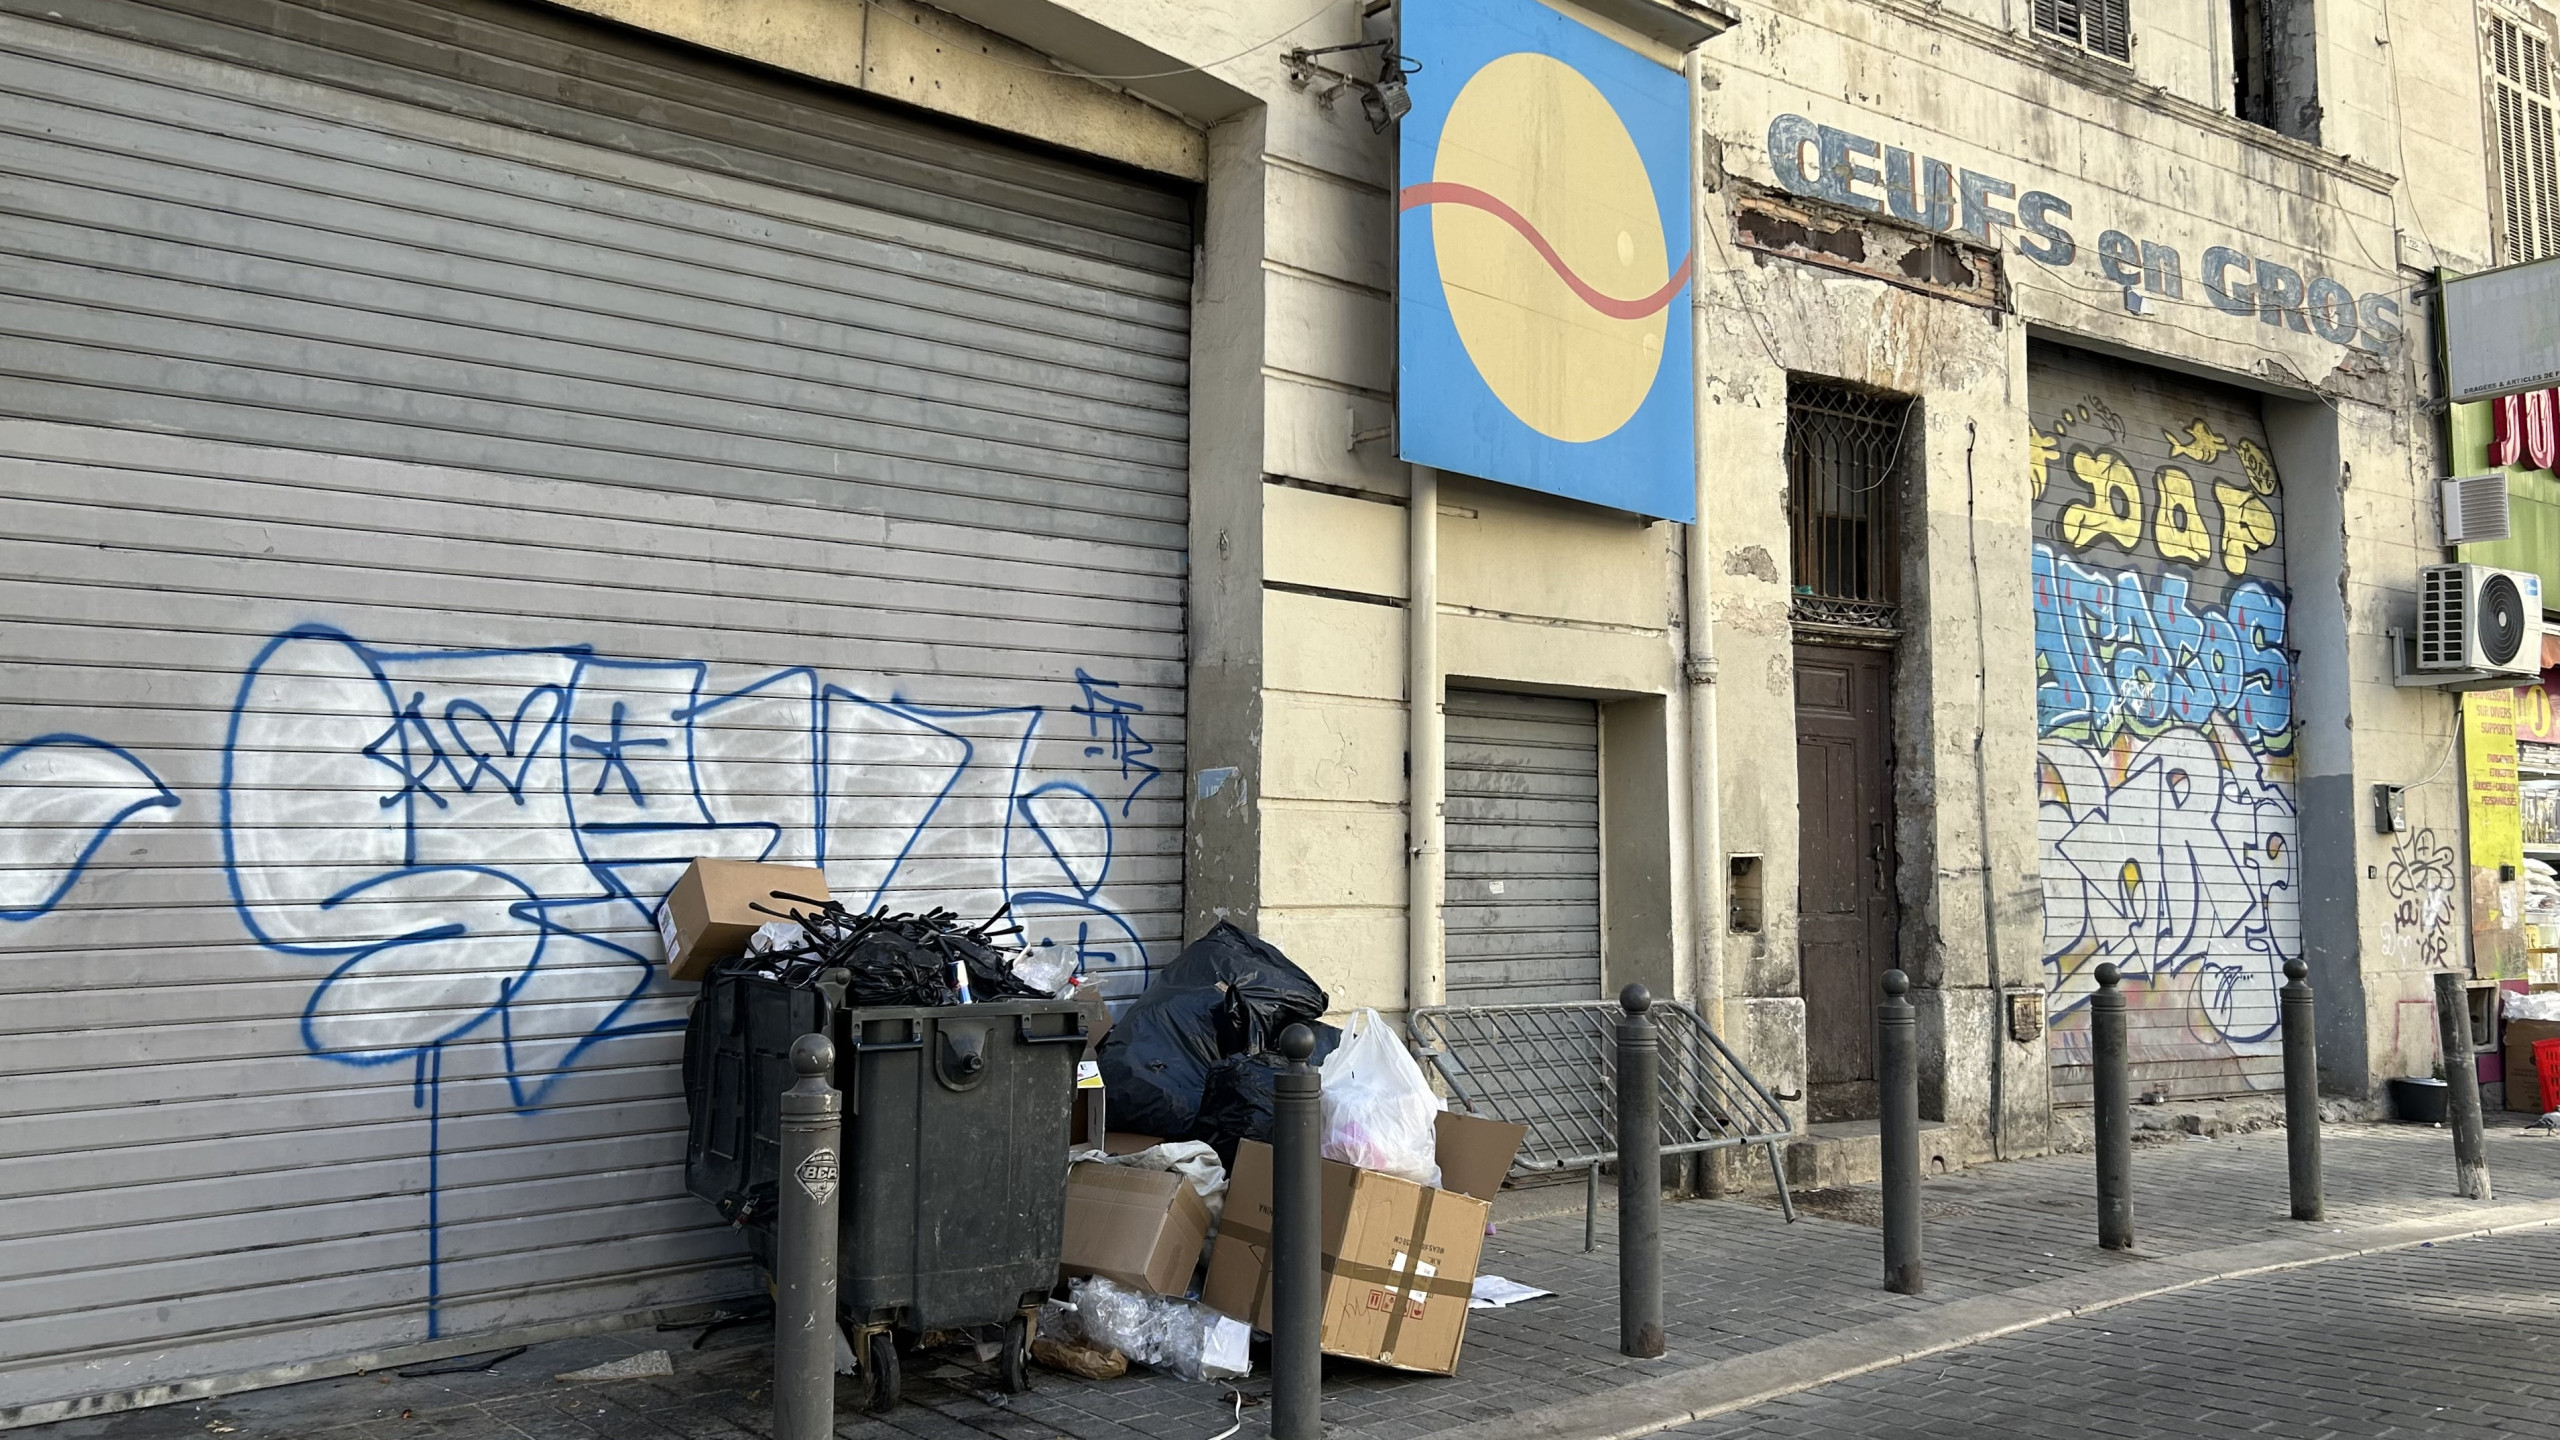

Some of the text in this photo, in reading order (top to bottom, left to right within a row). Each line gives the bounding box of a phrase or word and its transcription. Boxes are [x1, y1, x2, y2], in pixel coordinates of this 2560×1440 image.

[2098, 229, 2183, 300] en
[2201, 245, 2402, 353] GROS
[2506, 375, 2542, 386] ARTICLES
[2490, 706, 2512, 719] DIVERS
[2481, 722, 2513, 735] SUPPORTS
